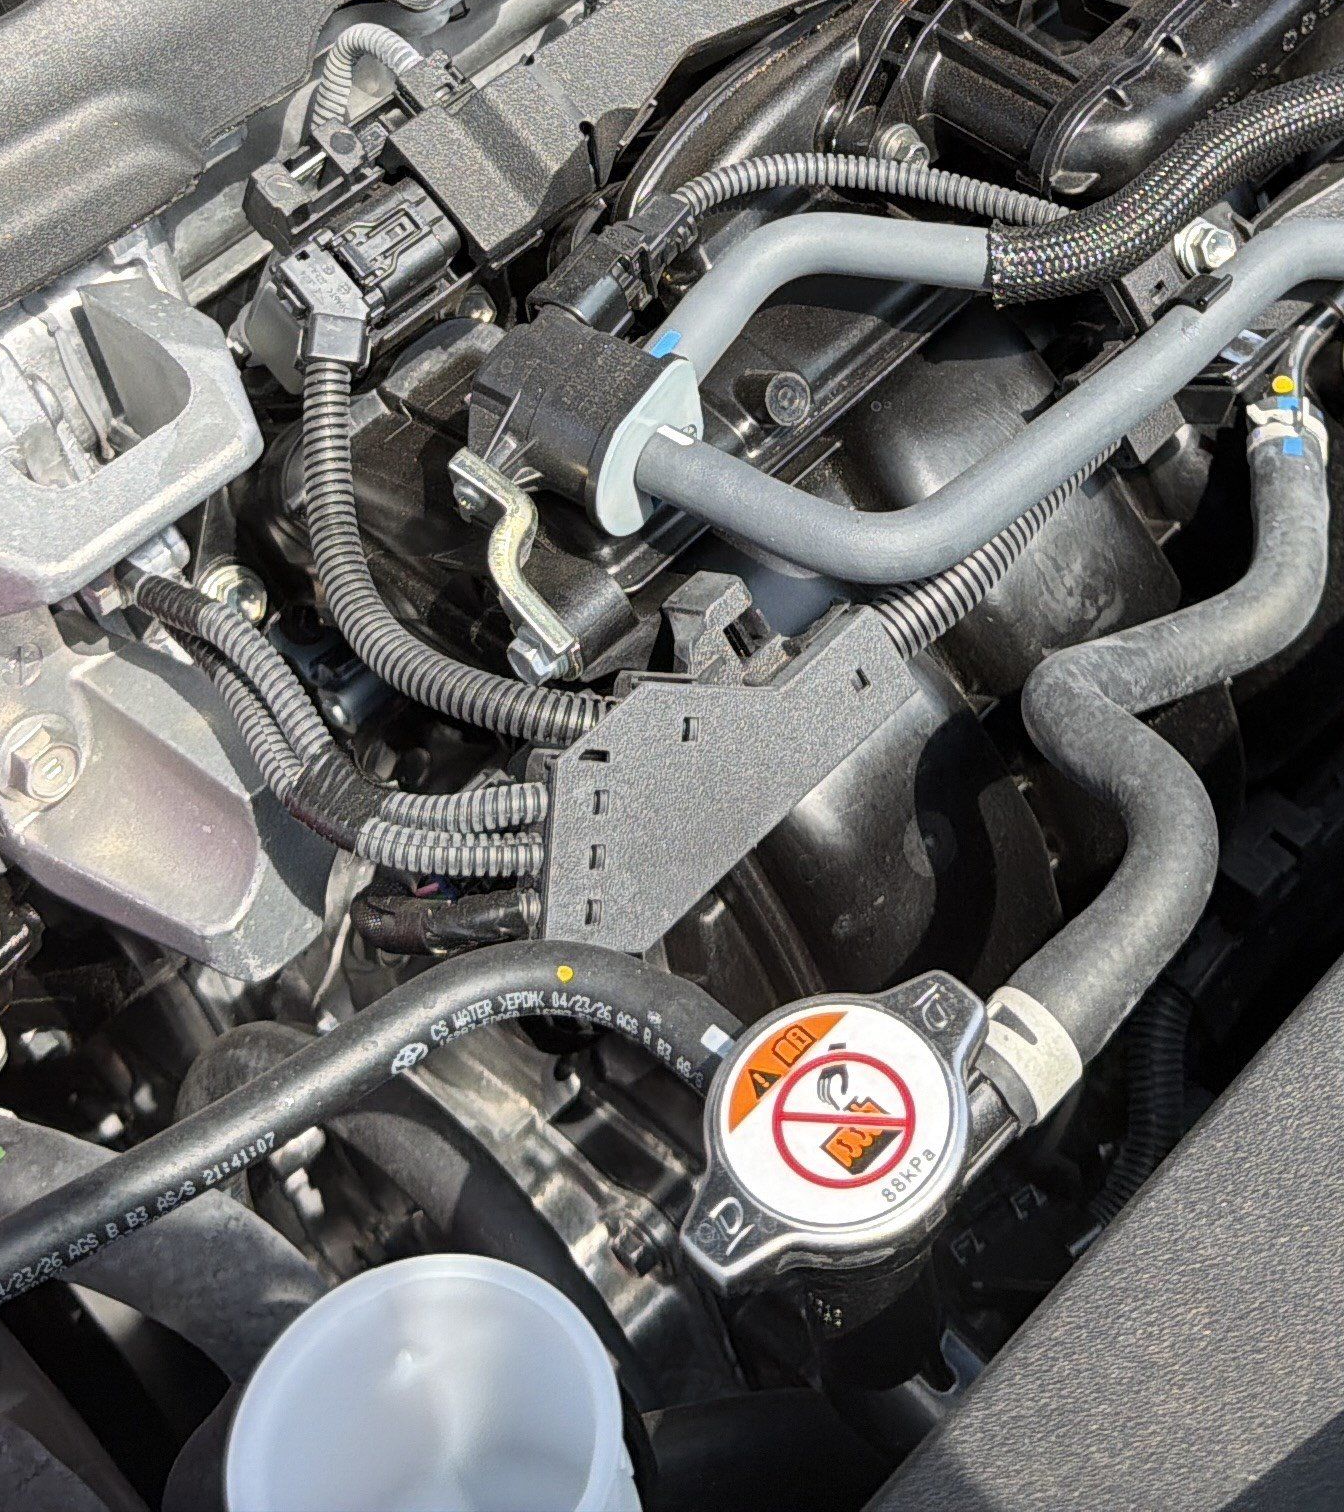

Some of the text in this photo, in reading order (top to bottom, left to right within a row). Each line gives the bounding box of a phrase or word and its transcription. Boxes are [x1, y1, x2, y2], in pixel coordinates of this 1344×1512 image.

[451, 999, 494, 1028] WATER
[202, 1131, 277, 1186] 21:41:07
[880, 1146, 937, 1203] 88kPa
